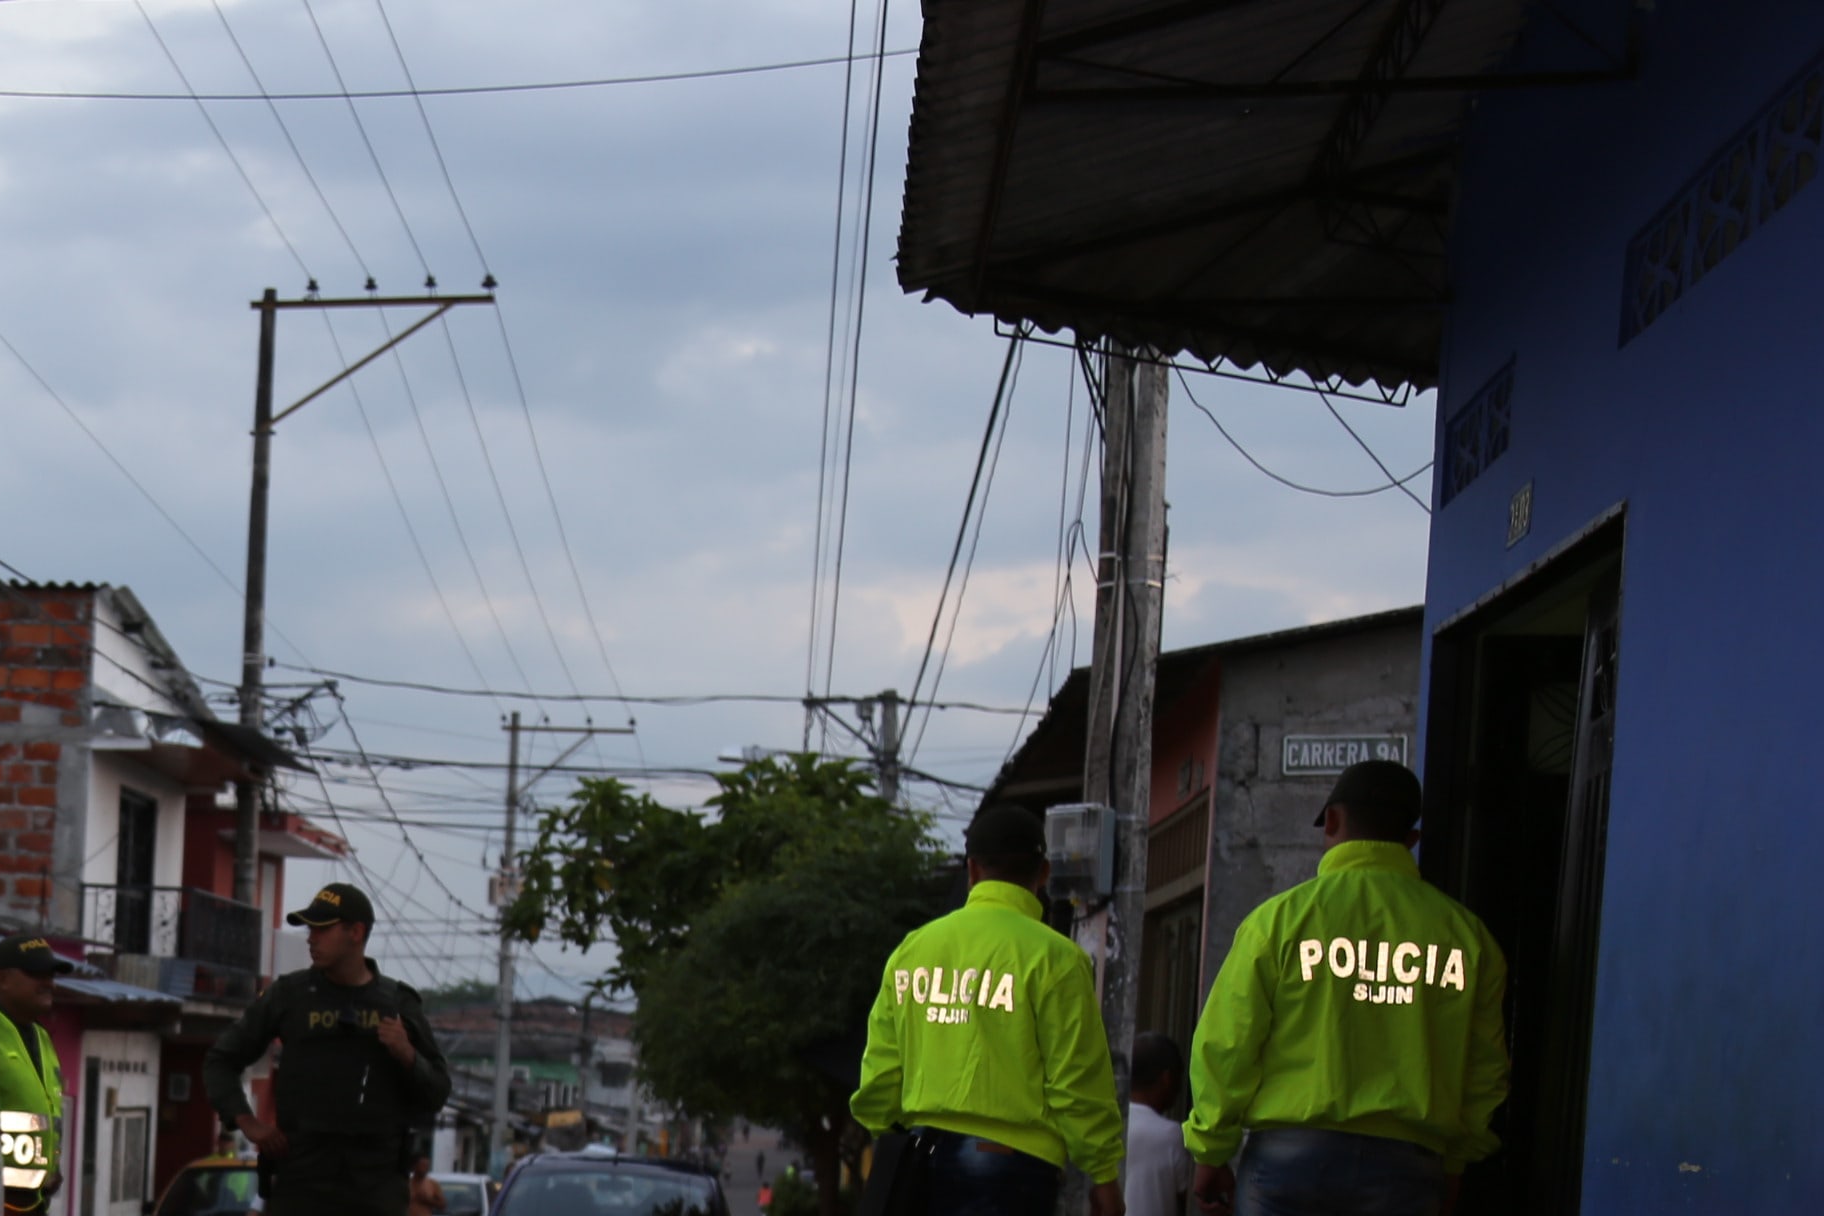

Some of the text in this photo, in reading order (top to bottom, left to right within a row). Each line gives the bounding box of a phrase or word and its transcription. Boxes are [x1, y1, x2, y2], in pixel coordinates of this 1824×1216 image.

[1287, 741, 1369, 767] CARRERA
[1299, 936, 1466, 992] POLICIA
[894, 966, 1014, 1013] POLICIA
